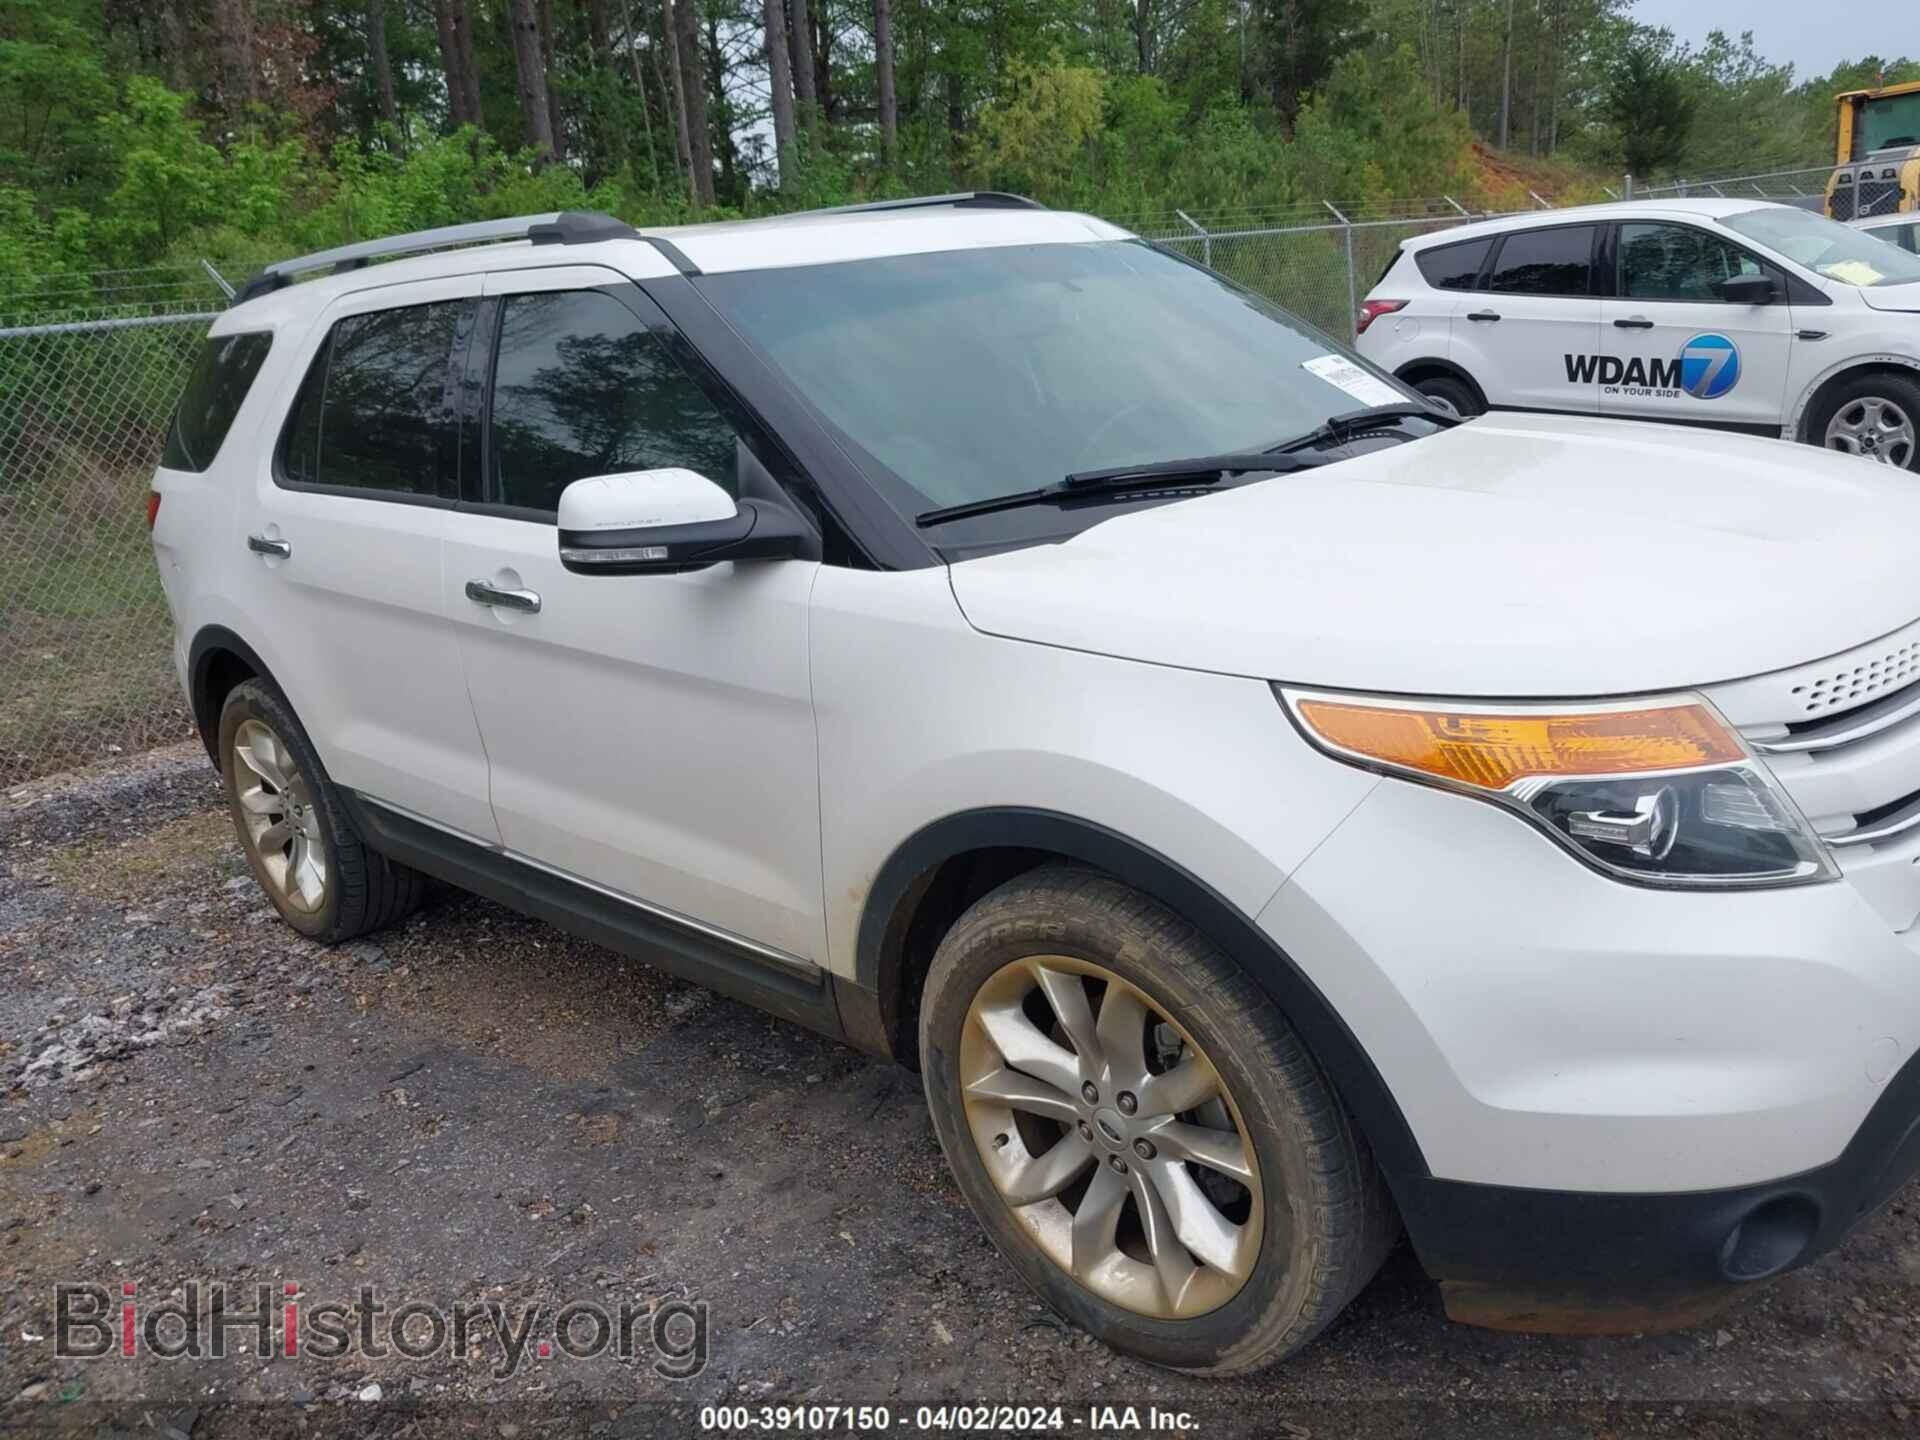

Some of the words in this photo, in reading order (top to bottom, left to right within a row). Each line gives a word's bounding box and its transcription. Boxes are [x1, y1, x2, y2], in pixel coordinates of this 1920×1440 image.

[1564, 354, 1682, 389] WDAM
[1683, 347, 1734, 398] 7
[1604, 386, 1619, 395] ON
[1623, 387, 1652, 397] YOUR
[1655, 389, 1681, 399] SIDE
